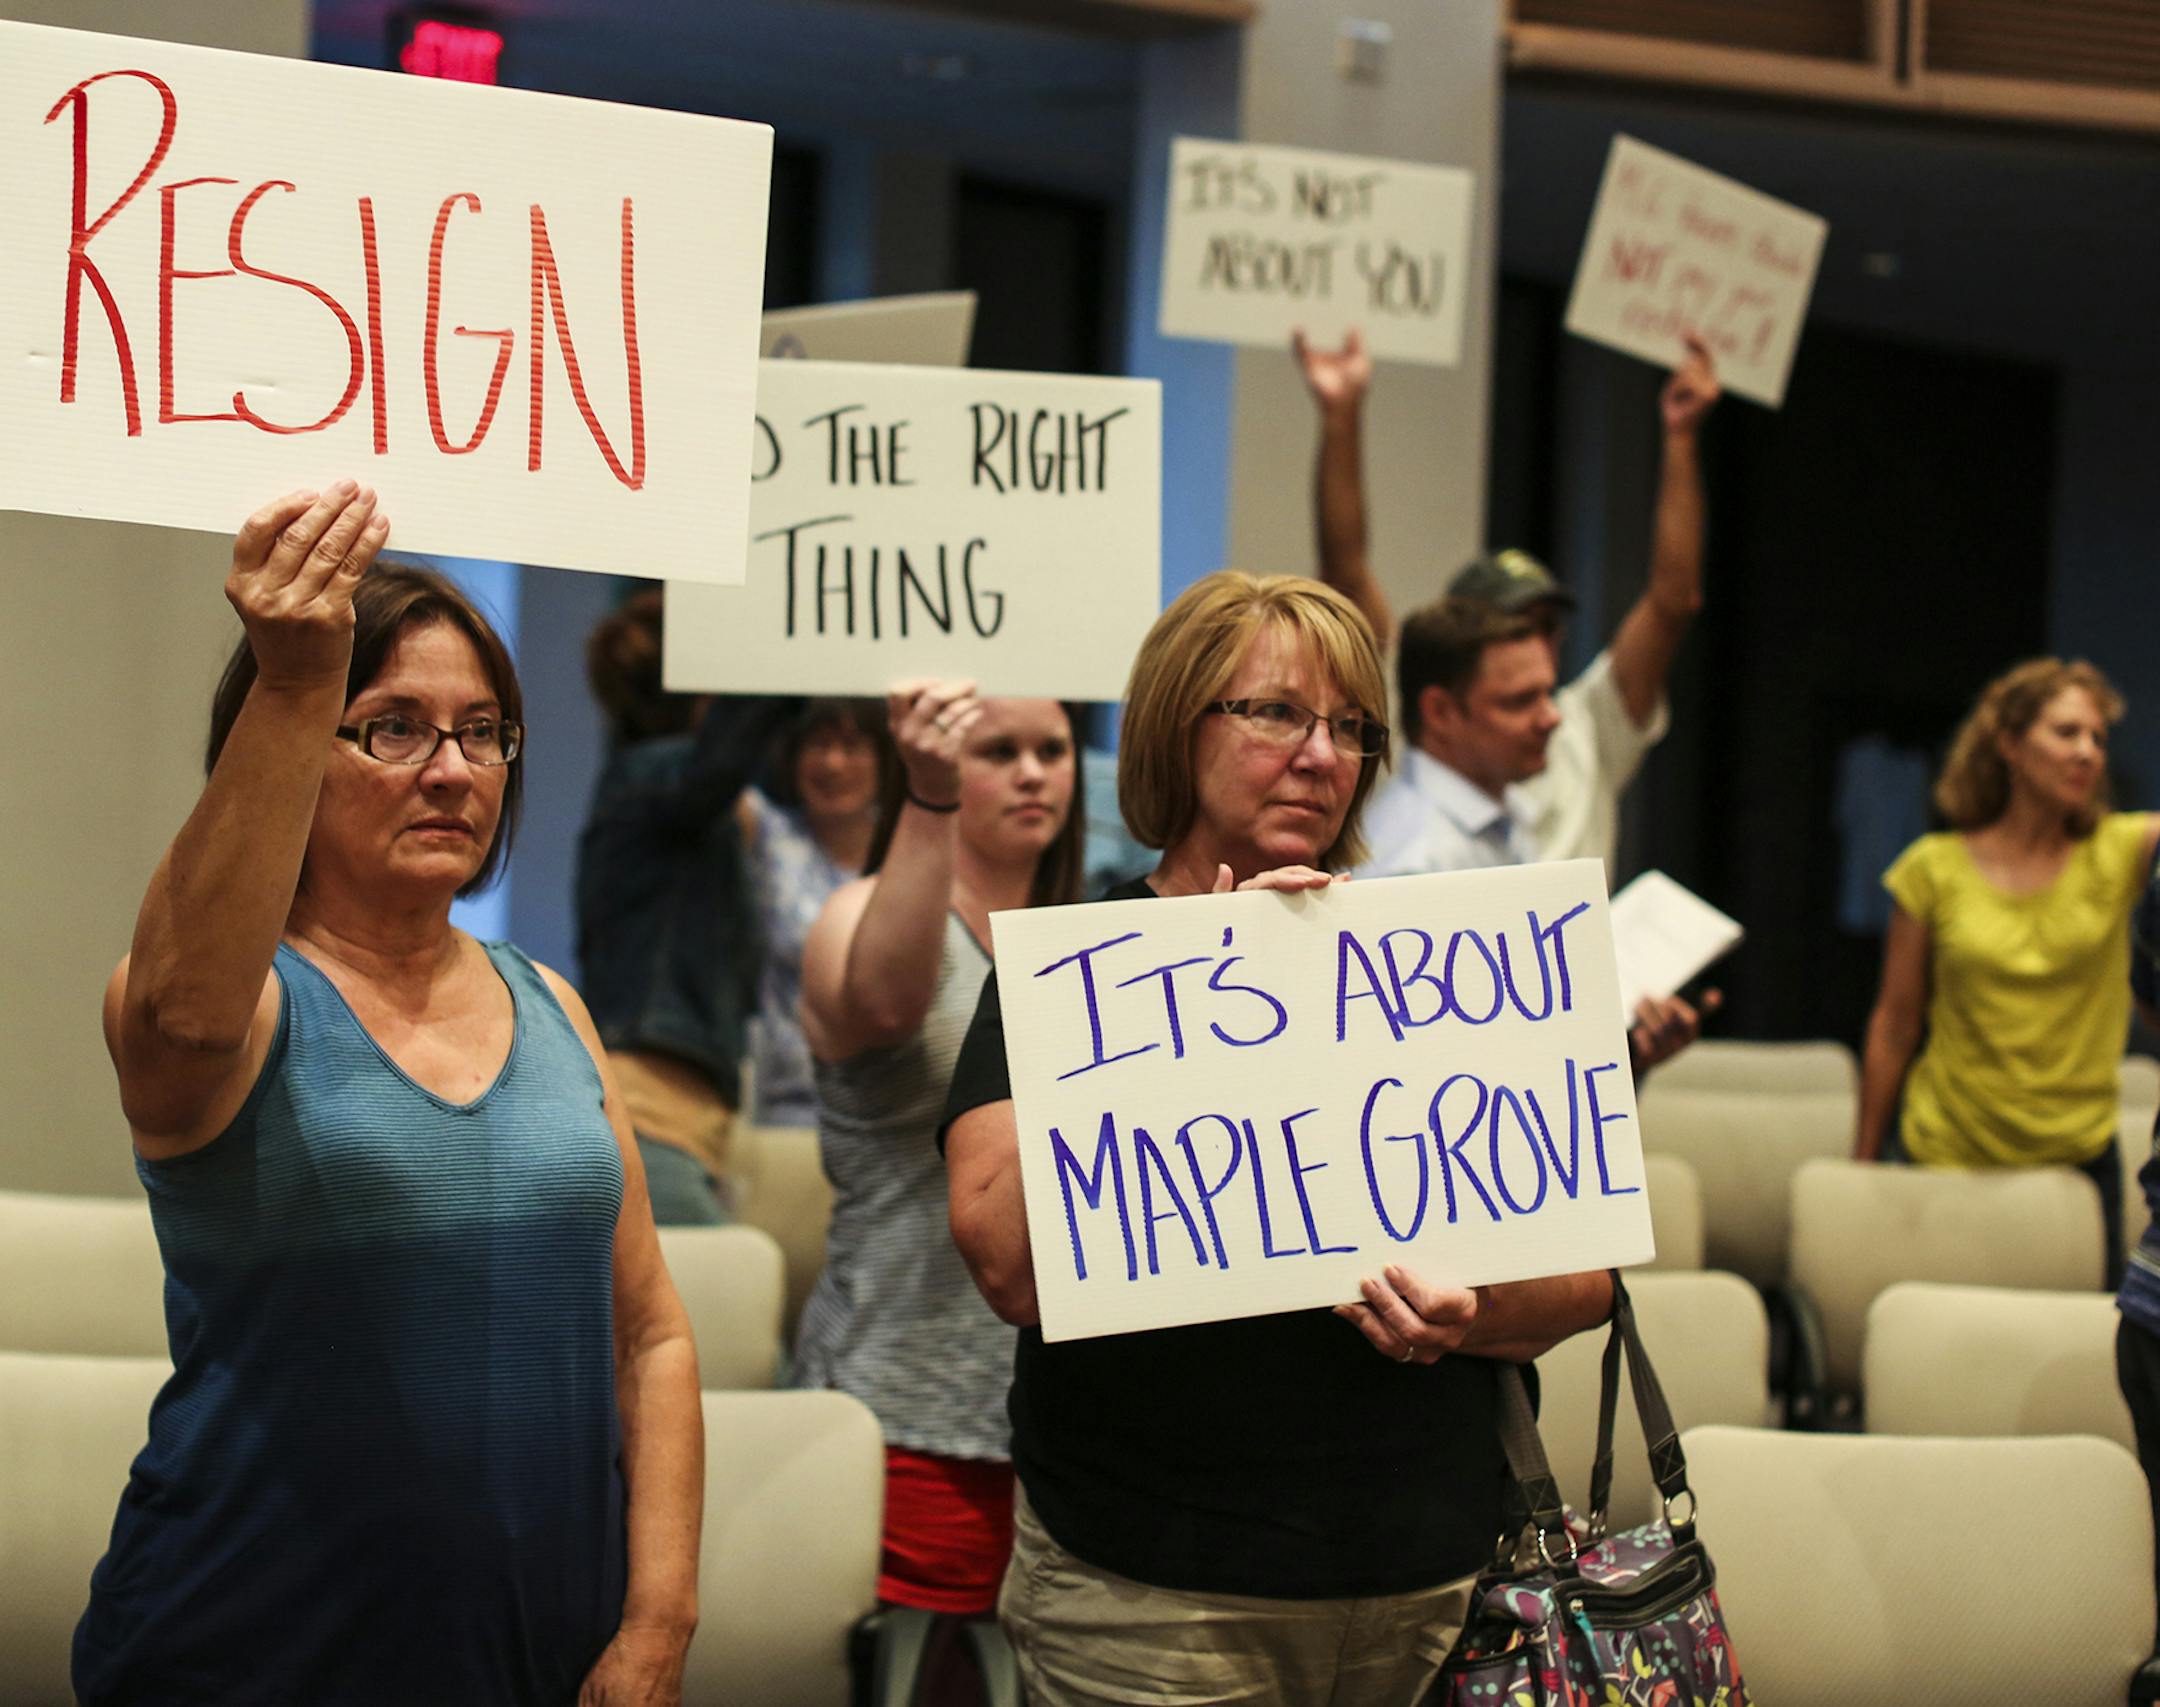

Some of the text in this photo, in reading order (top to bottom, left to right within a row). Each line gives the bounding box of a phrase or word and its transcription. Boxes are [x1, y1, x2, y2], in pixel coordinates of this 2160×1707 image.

[1292, 168, 1388, 223] NOT
[43, 69, 645, 491] RESIGN
[1199, 232, 1446, 317] ABOUT YOU
[802, 402, 918, 488] THE
[967, 401, 1131, 496] RIGHT
[753, 513, 1006, 642] THING
[1033, 902, 1591, 1082] IT'S ABOUT
[1048, 1058, 1640, 1281] MAPLE GROVE
